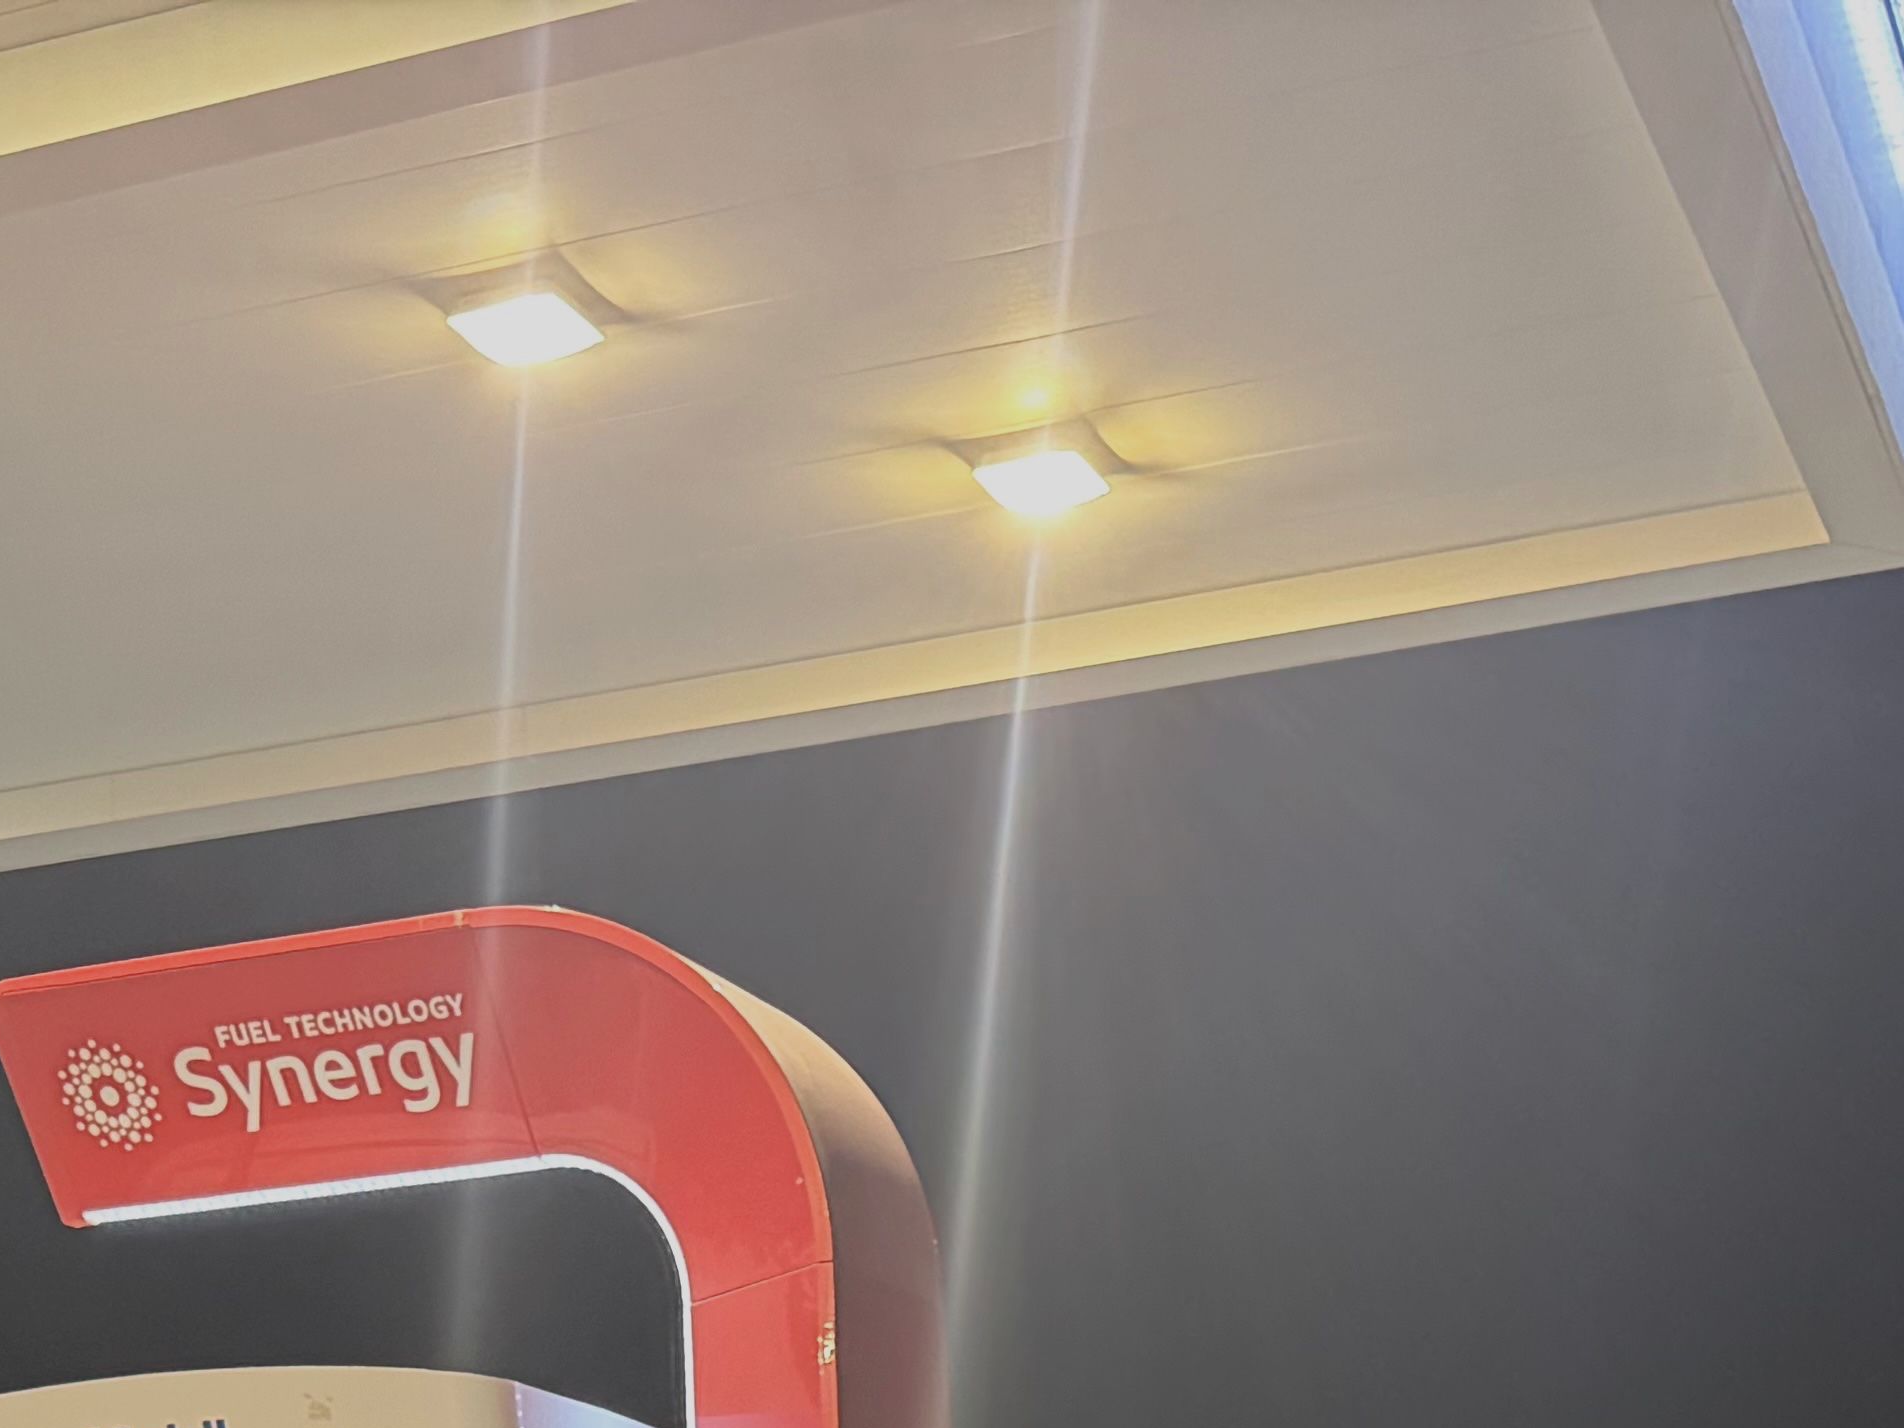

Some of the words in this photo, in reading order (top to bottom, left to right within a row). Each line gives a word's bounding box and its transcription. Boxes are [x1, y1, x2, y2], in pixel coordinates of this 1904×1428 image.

[214, 1019, 282, 1049] FUEL
[284, 993, 464, 1040] TECHNOLOGY
[173, 1032, 475, 1133] Synergy
